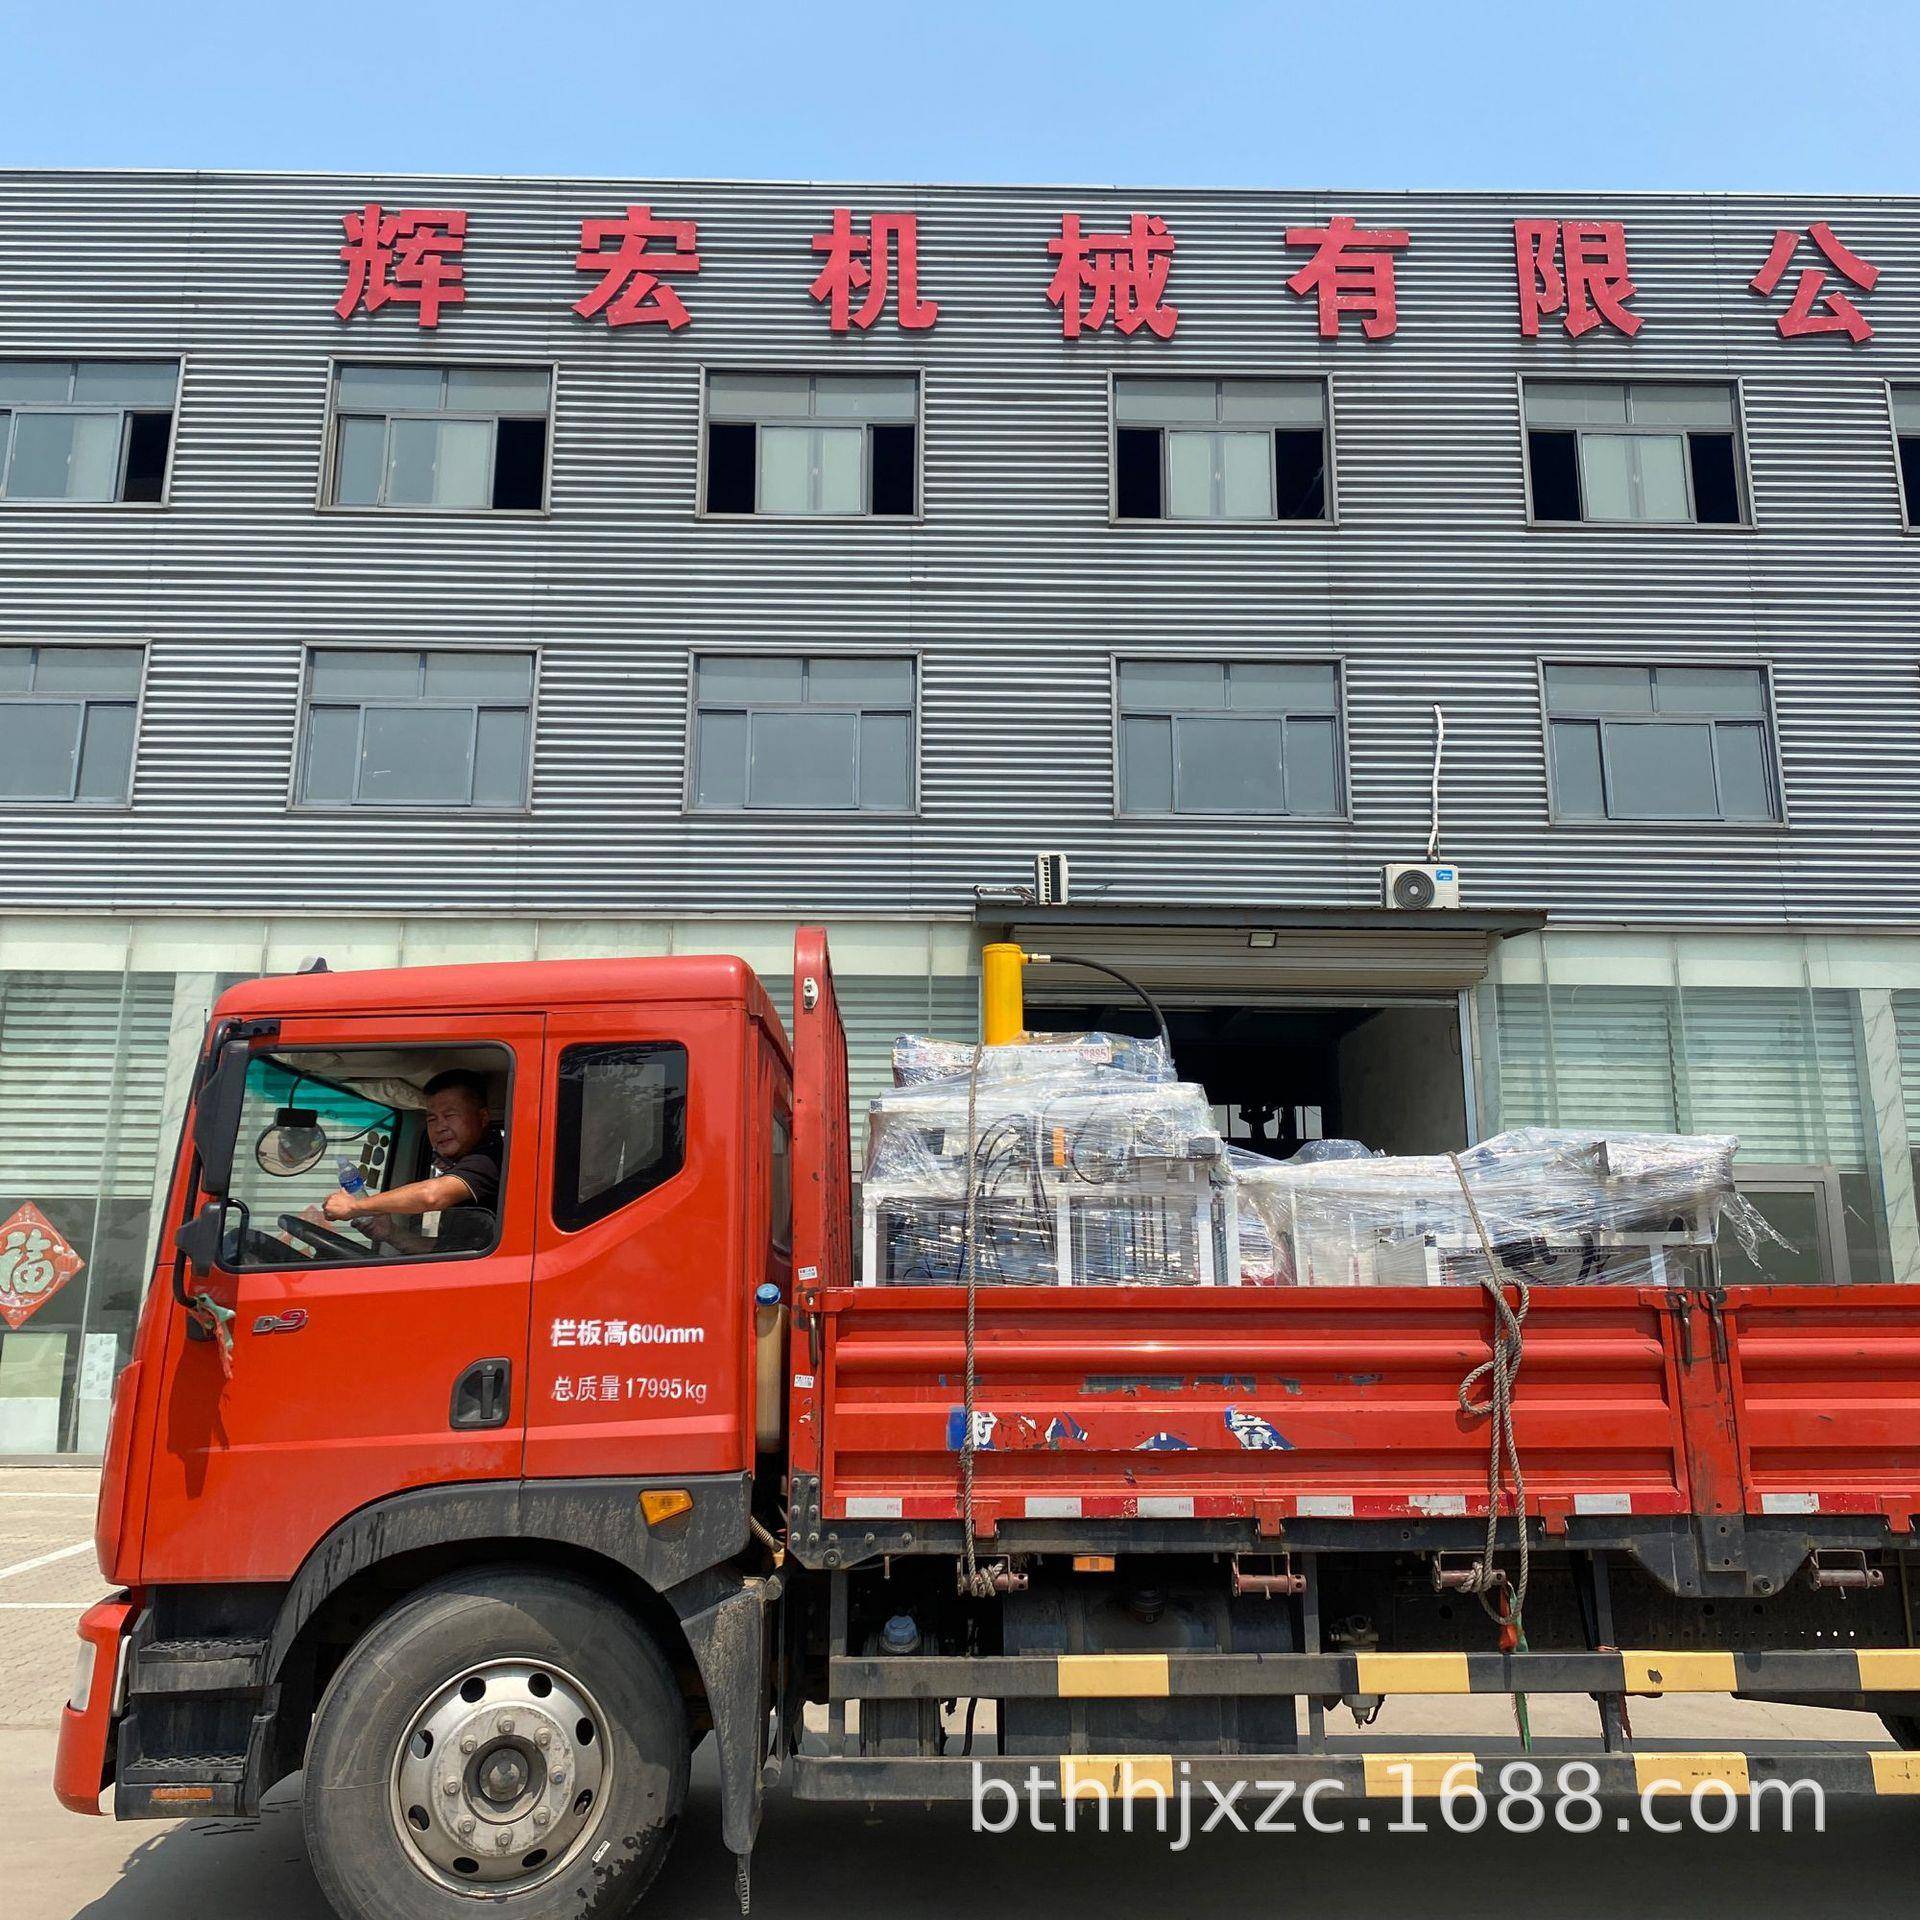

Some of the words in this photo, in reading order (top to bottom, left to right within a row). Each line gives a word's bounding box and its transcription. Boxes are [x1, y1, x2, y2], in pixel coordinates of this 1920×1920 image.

[333, 203, 1881, 344] 辉宏机械有限公
[253, 1308, 308, 1335] D9
[551, 1318, 704, 1347] 栏板高600mm
